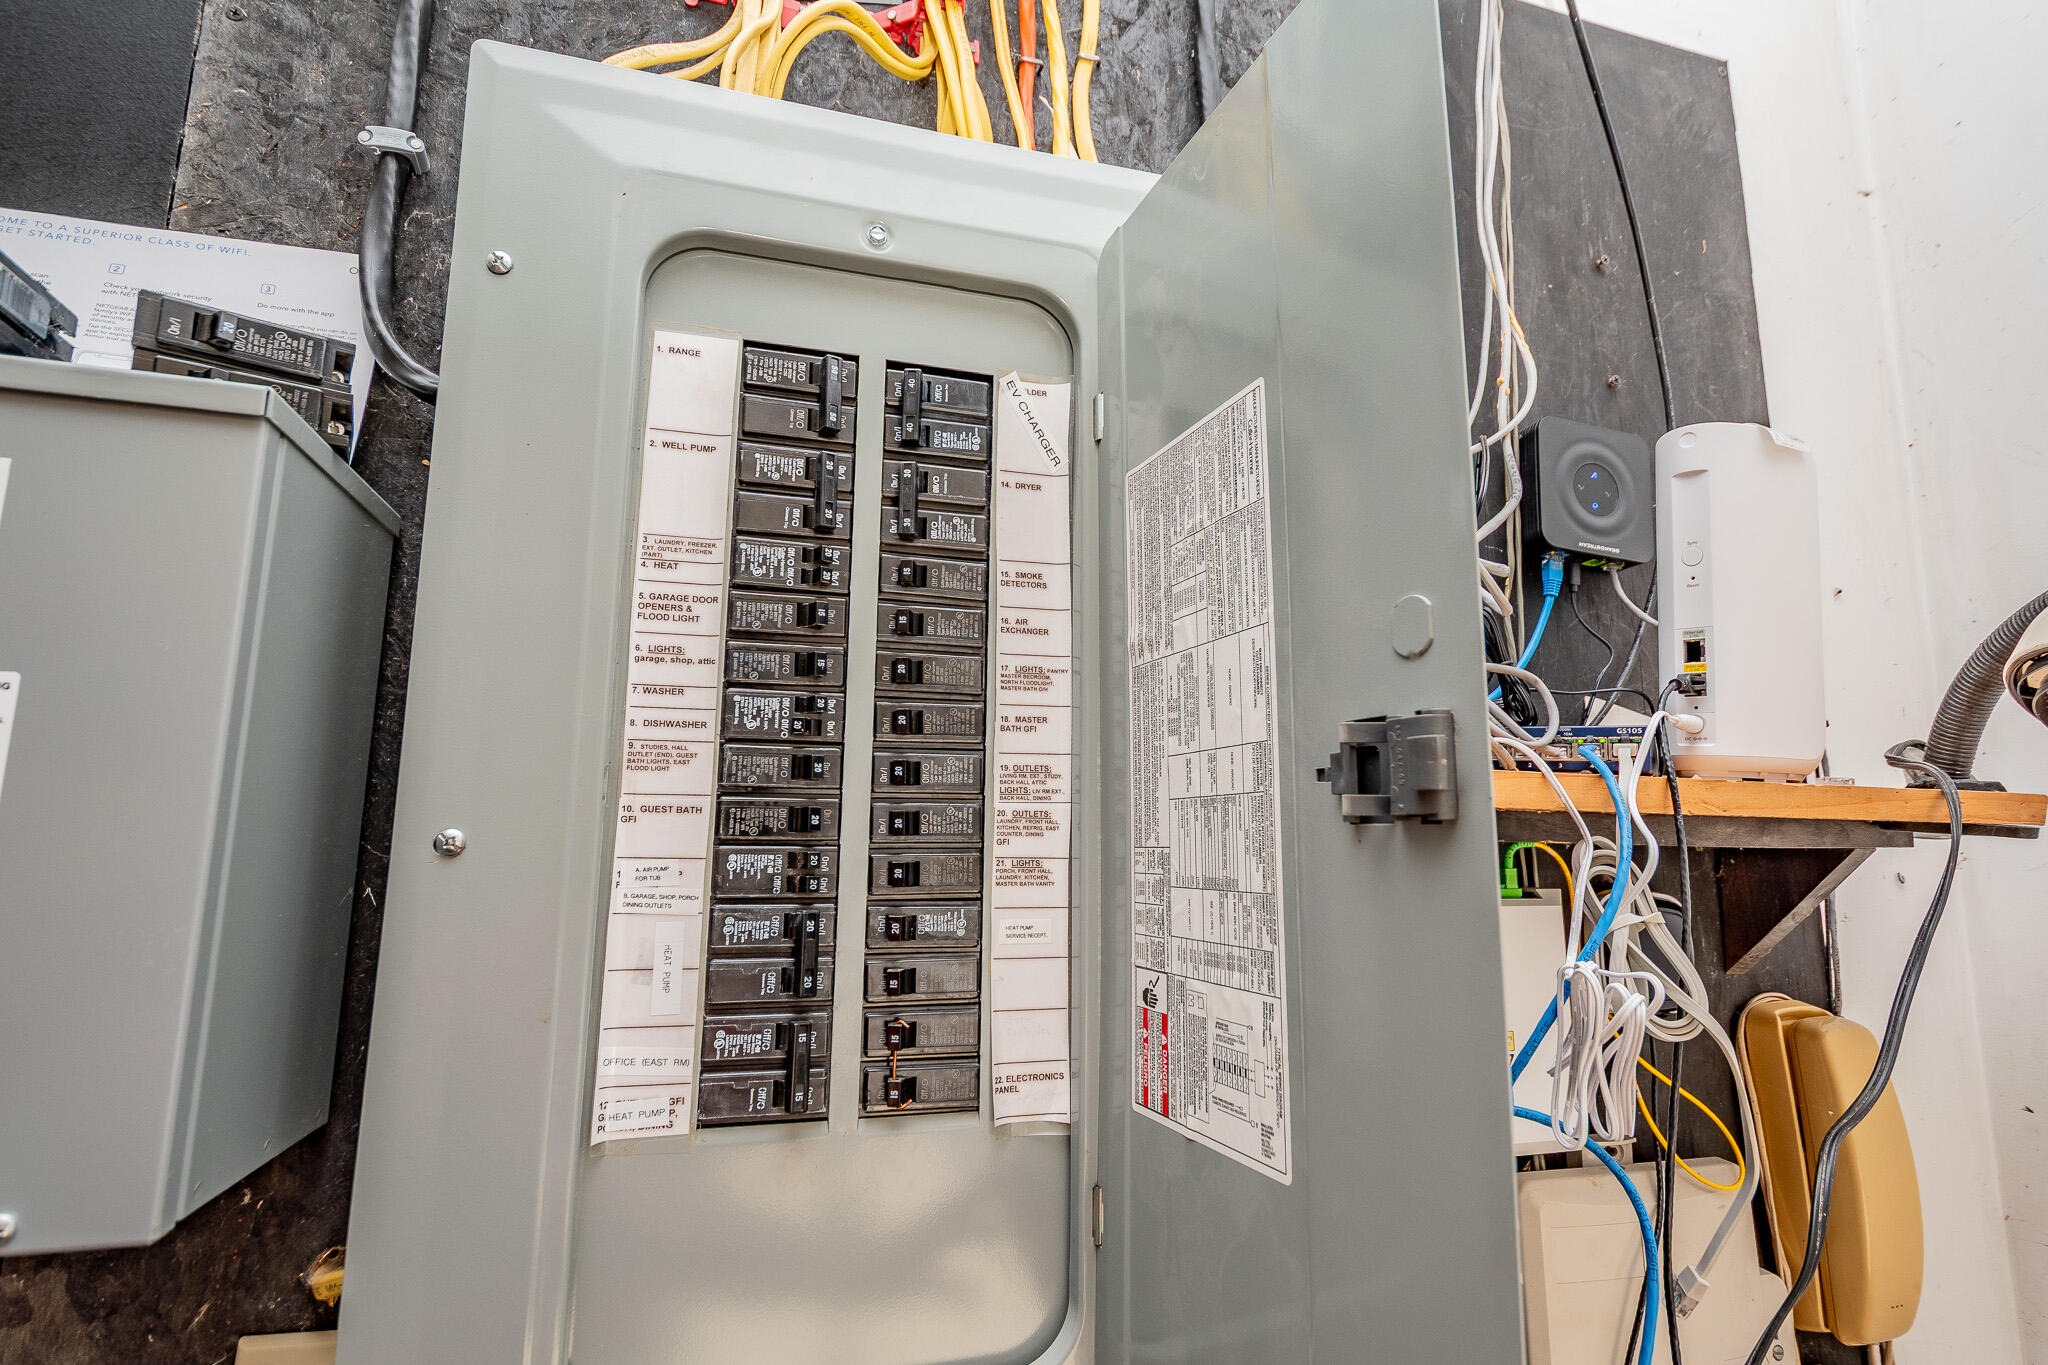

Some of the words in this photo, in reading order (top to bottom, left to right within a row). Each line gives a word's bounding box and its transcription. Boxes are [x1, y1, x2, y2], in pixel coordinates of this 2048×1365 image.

[28, 229, 95, 247] STARTED.
[33, 220, 53, 229] TO
[74, 227, 143, 247] SUPERIOR
[148, 236, 190, 249] CLASS
[195, 242, 215, 252] OF
[113, 265, 121, 273] 2
[657, 345, 664, 353] 1.
[668, 347, 701, 357] RANGE
[831, 364, 838, 375] 50
[908, 378, 916, 388] 40
[1006, 380, 1022, 398] EV
[1018, 401, 1062, 468] CHARGER
[650, 439, 657, 448] 2.
[662, 441, 688, 450] WELL
[690, 443, 717, 453] PUMP
[1016, 483, 1042, 491] DRYER
[685, 548, 712, 556] KITCHEN
[654, 562, 678, 570] HEAT
[1015, 572, 1043, 580] SMOKE
[1001, 580, 1047, 589] DETECTORS
[649, 593, 690, 603] GARAGE
[692, 595, 718, 604] DOOR
[638, 602, 684, 612] OPENERS
[686, 604, 693, 612] &
[637, 613, 670, 622] FLOOD
[672, 614, 700, 623] LIGHT
[1000, 627, 1049, 636] EXCHANGER
[648, 645, 685, 655] LIGHTS:
[634, 656, 668, 665] garage,
[670, 656, 695, 665] shop,
[697, 657, 716, 665] attic
[1015, 666, 1046, 674] LIGHTS:
[642, 687, 684, 696] WASHER
[817, 698, 825, 708] 20
[630, 719, 638, 727] 8.
[643, 720, 707, 729] DISHWASHER
[627, 751, 653, 759] OUTLET
[1013, 765, 1052, 773] OUTLETS:
[621, 805, 634, 813] 10.
[640, 805, 674, 814] GUEST
[677, 806, 702, 814] BATH
[1012, 810, 1052, 818] OUTLETS:
[621, 815, 637, 823] GFI
[997, 838, 1010, 846] GFI
[1011, 860, 1043, 868] LIGHTS:
[894, 868, 903, 880] 20
[664, 944, 672, 967] HEAT
[662, 972, 671, 994] PUMP
[603, 1058, 636, 1067] OFFICE
[642, 1058, 671, 1068] (EAST
[673, 1058, 690, 1068] RM)
[1142, 1042, 1150, 1088] PELIGRO
[994, 1076, 1004, 1084] 22.
[1005, 1072, 1065, 1083] ELECTRONICS
[890, 1089, 899, 1099] 15
[995, 1085, 1020, 1094] PANEL
[608, 1111, 633, 1121] HEAT
[638, 1108, 665, 1119] PUMP
